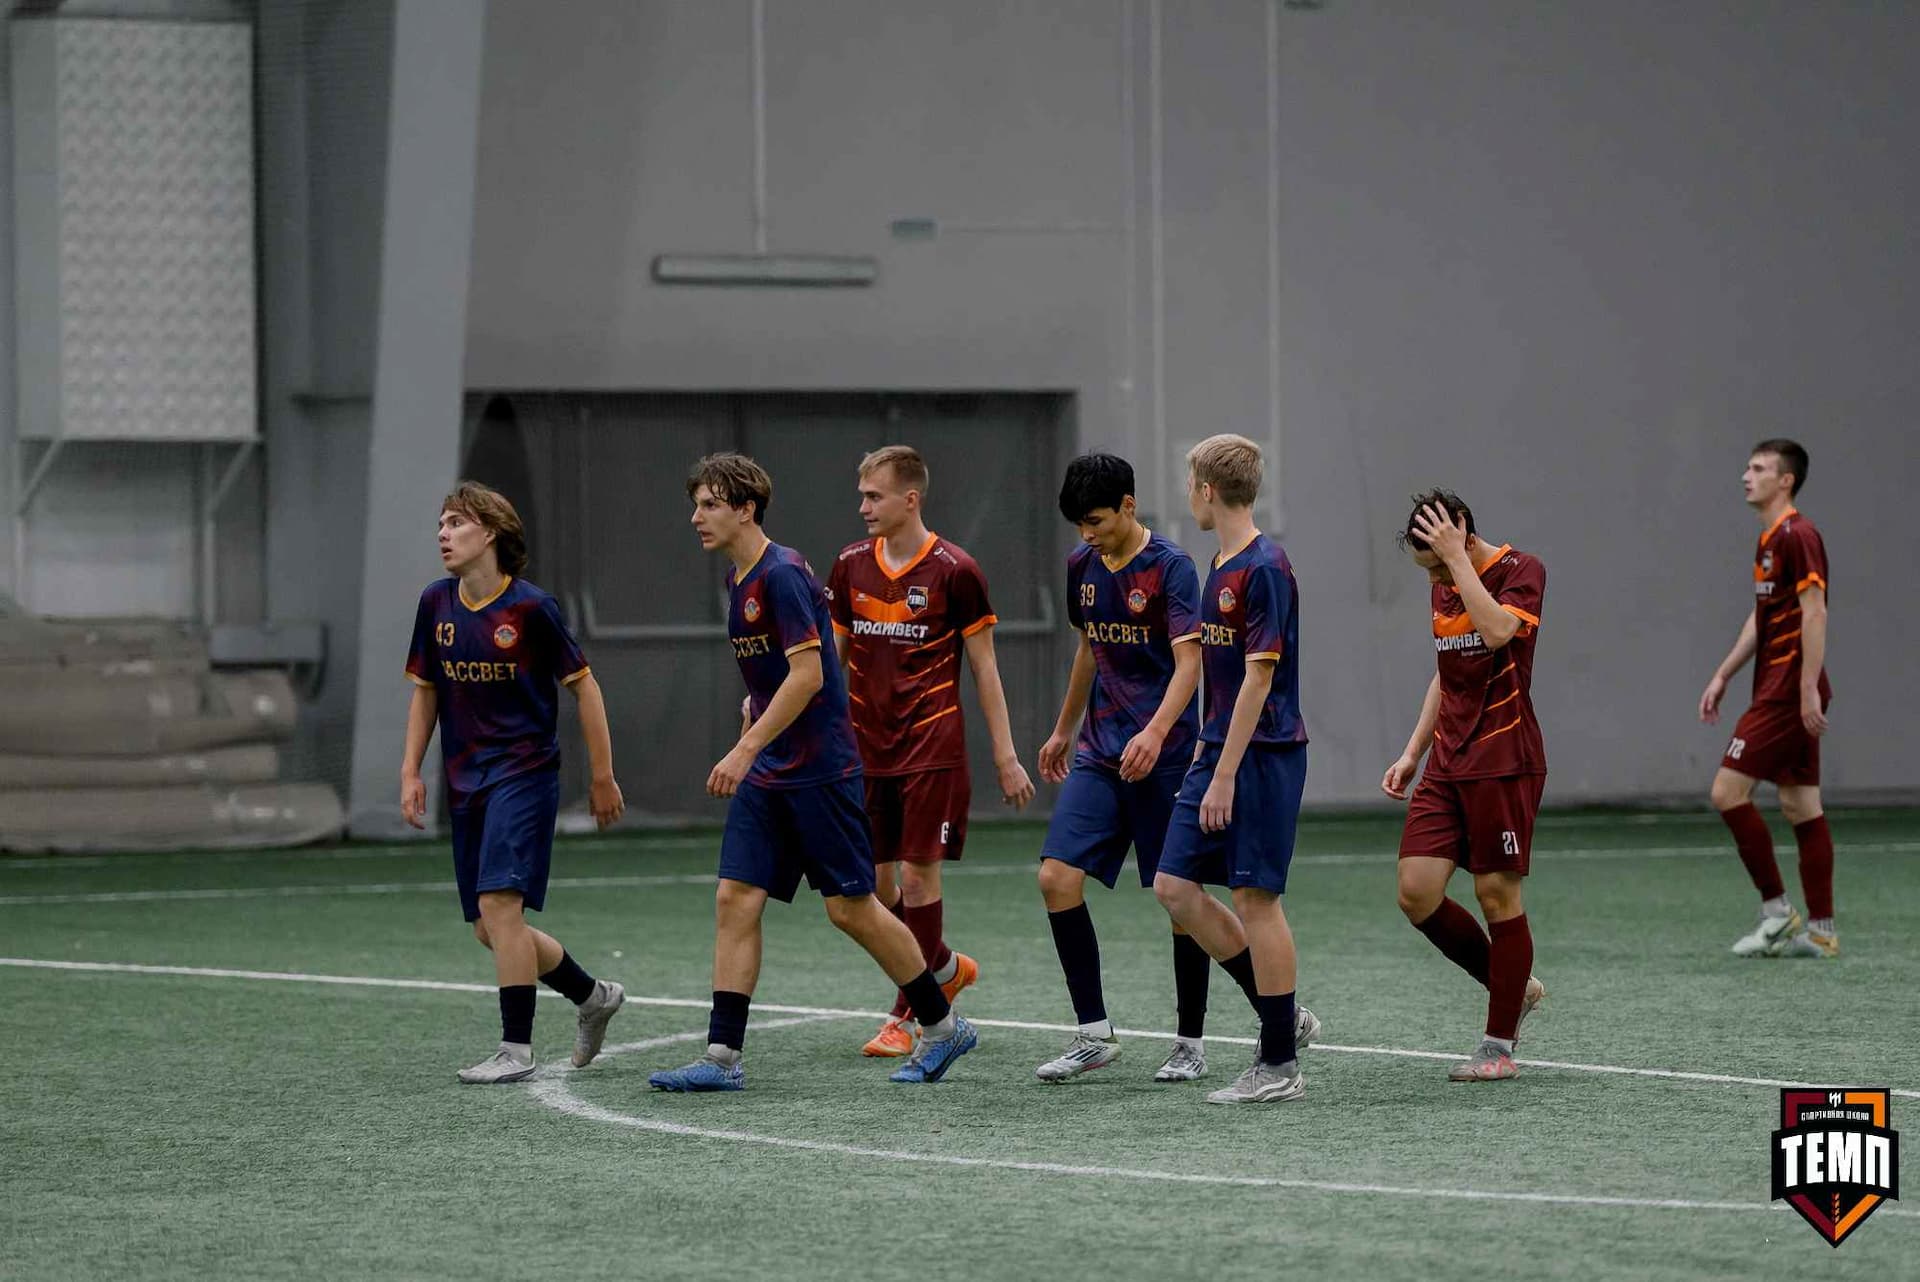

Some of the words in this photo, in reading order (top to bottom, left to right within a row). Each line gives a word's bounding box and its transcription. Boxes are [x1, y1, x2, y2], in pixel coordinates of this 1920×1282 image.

[1084, 621, 1151, 644] АССВЕТ
[940, 821, 950, 845] 6
[1502, 831, 1520, 855] 21
